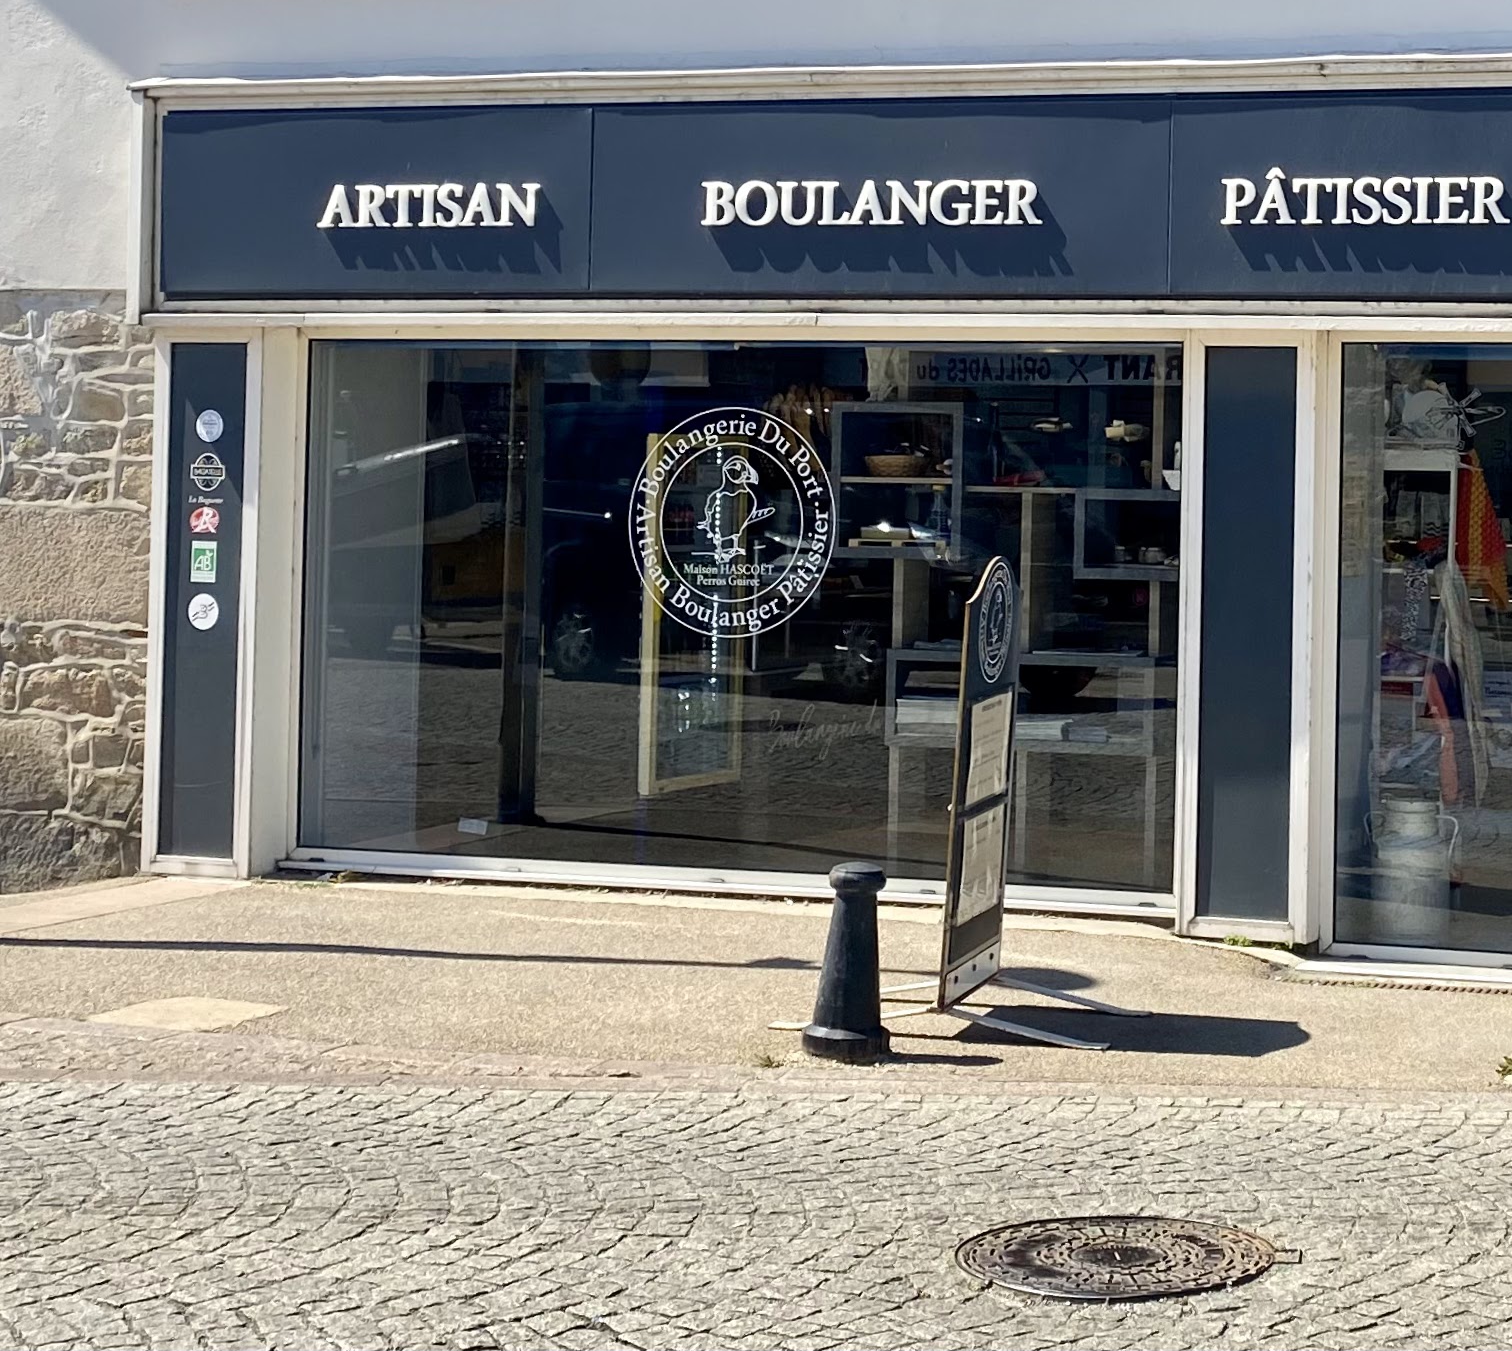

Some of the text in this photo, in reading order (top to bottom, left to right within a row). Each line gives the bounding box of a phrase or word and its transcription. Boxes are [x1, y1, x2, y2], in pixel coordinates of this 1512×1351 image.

[316, 167, 1510, 229] ARTISAN BOULANGER PÂTISSIER
[637, 413, 825, 498] Boulangerie Du Port
[636, 504, 830, 632] Artisan Boulanger Pâtissier
[683, 561, 774, 575] Maison HASCOËT
[697, 575, 761, 586] Perros Guirec
